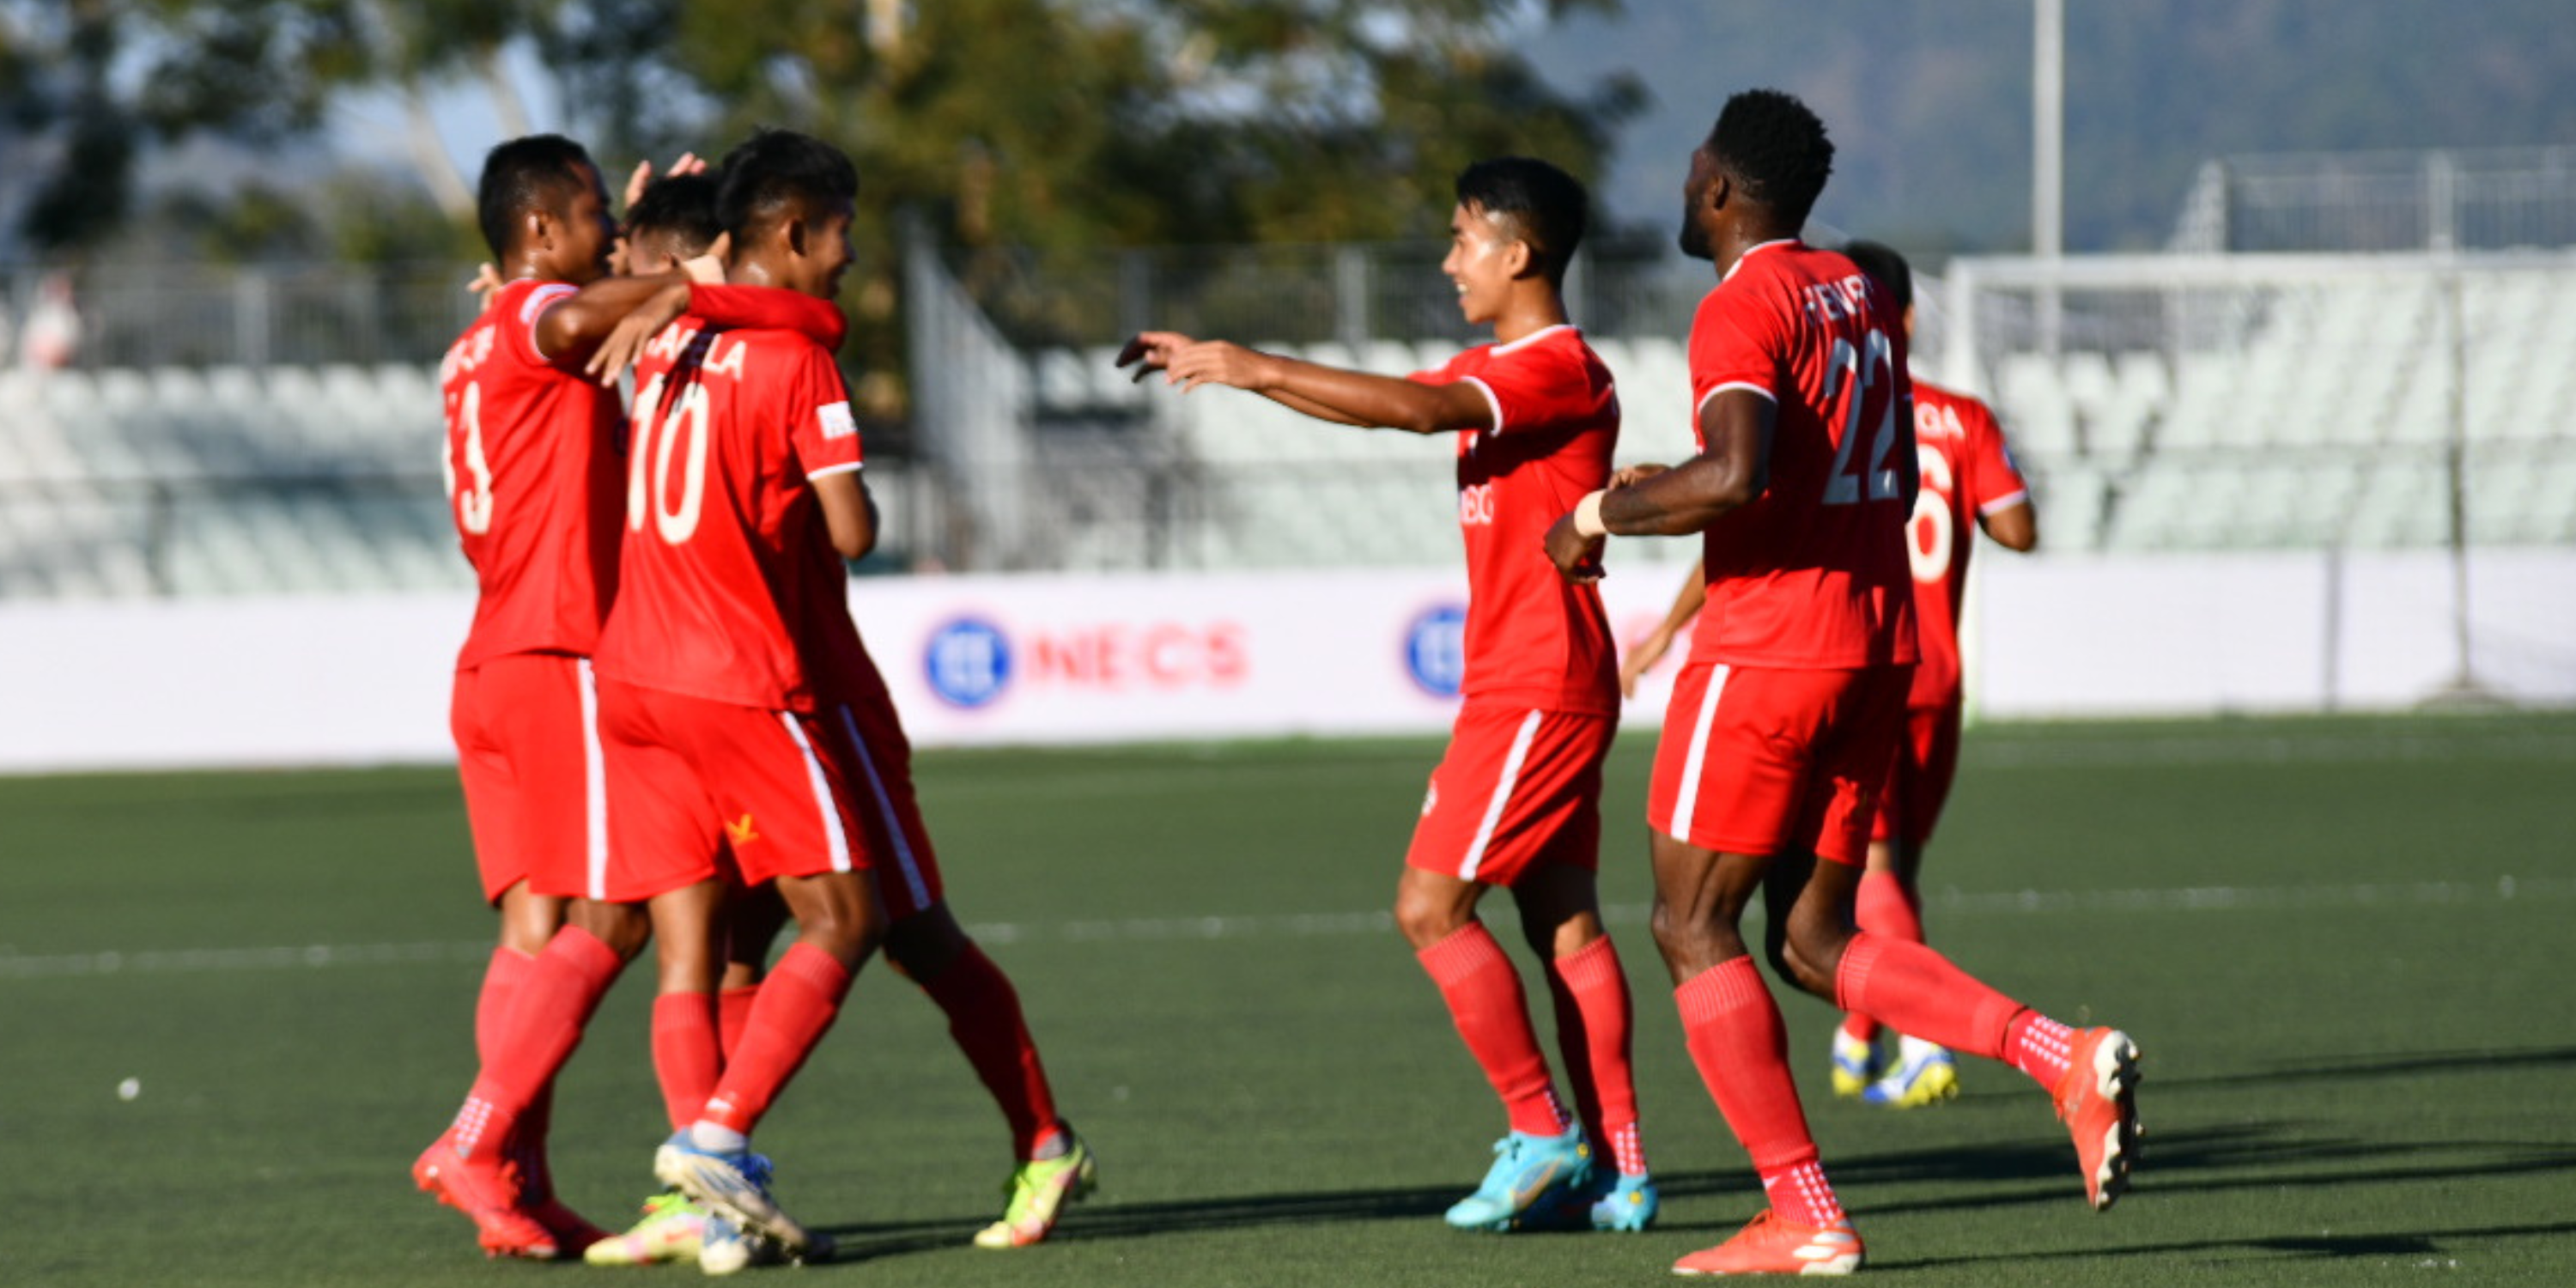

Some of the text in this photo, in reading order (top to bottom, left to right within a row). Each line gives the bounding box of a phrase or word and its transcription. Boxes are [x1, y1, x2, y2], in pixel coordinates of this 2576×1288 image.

[628, 371, 710, 546] 10
[1821, 329, 1900, 505] 22
[1905, 443, 1953, 585] 6
[1027, 621, 1252, 690] NECS
